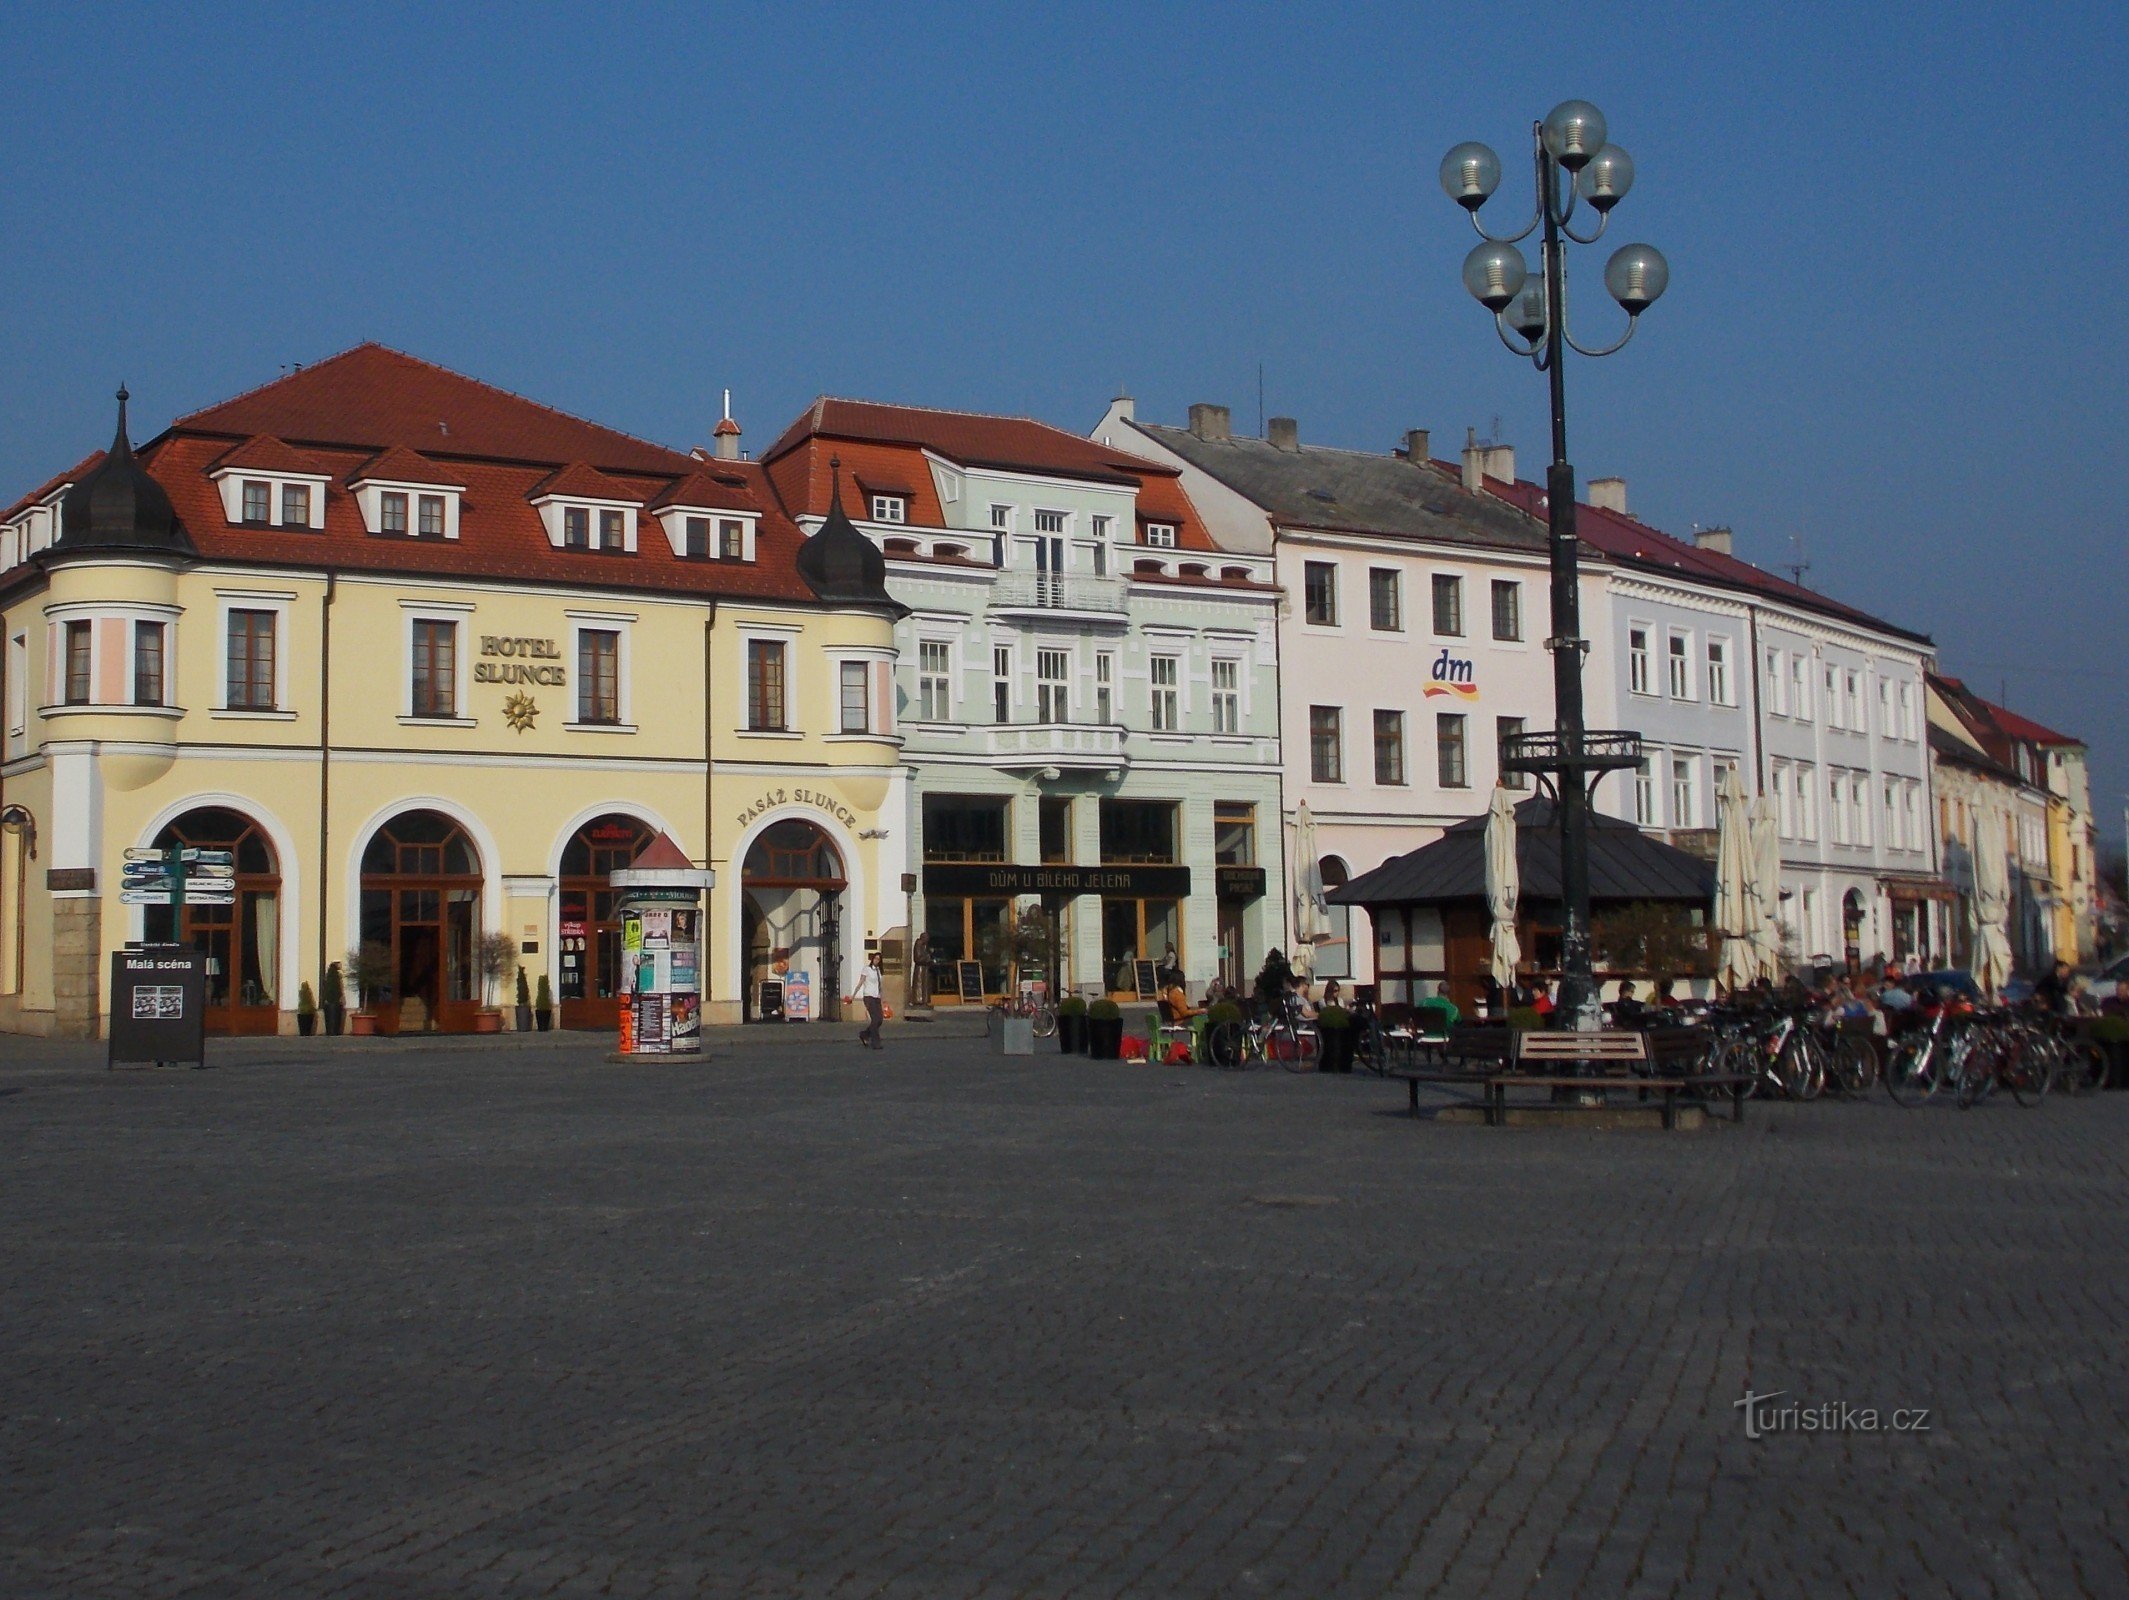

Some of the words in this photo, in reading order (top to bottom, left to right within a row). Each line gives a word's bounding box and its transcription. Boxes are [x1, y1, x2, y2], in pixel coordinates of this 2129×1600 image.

[480, 636, 561, 659] HOTEL
[474, 662, 566, 686] SLUNCE
[1432, 648, 1473, 682] dm
[737, 787, 788, 828] PASÁŽ
[794, 788, 857, 829] SLUNCE
[1023, 873, 1031, 887] U
[1085, 873, 1131, 888] JELENA
[126, 959, 154, 969] Malá
[157, 959, 192, 969] scéna
